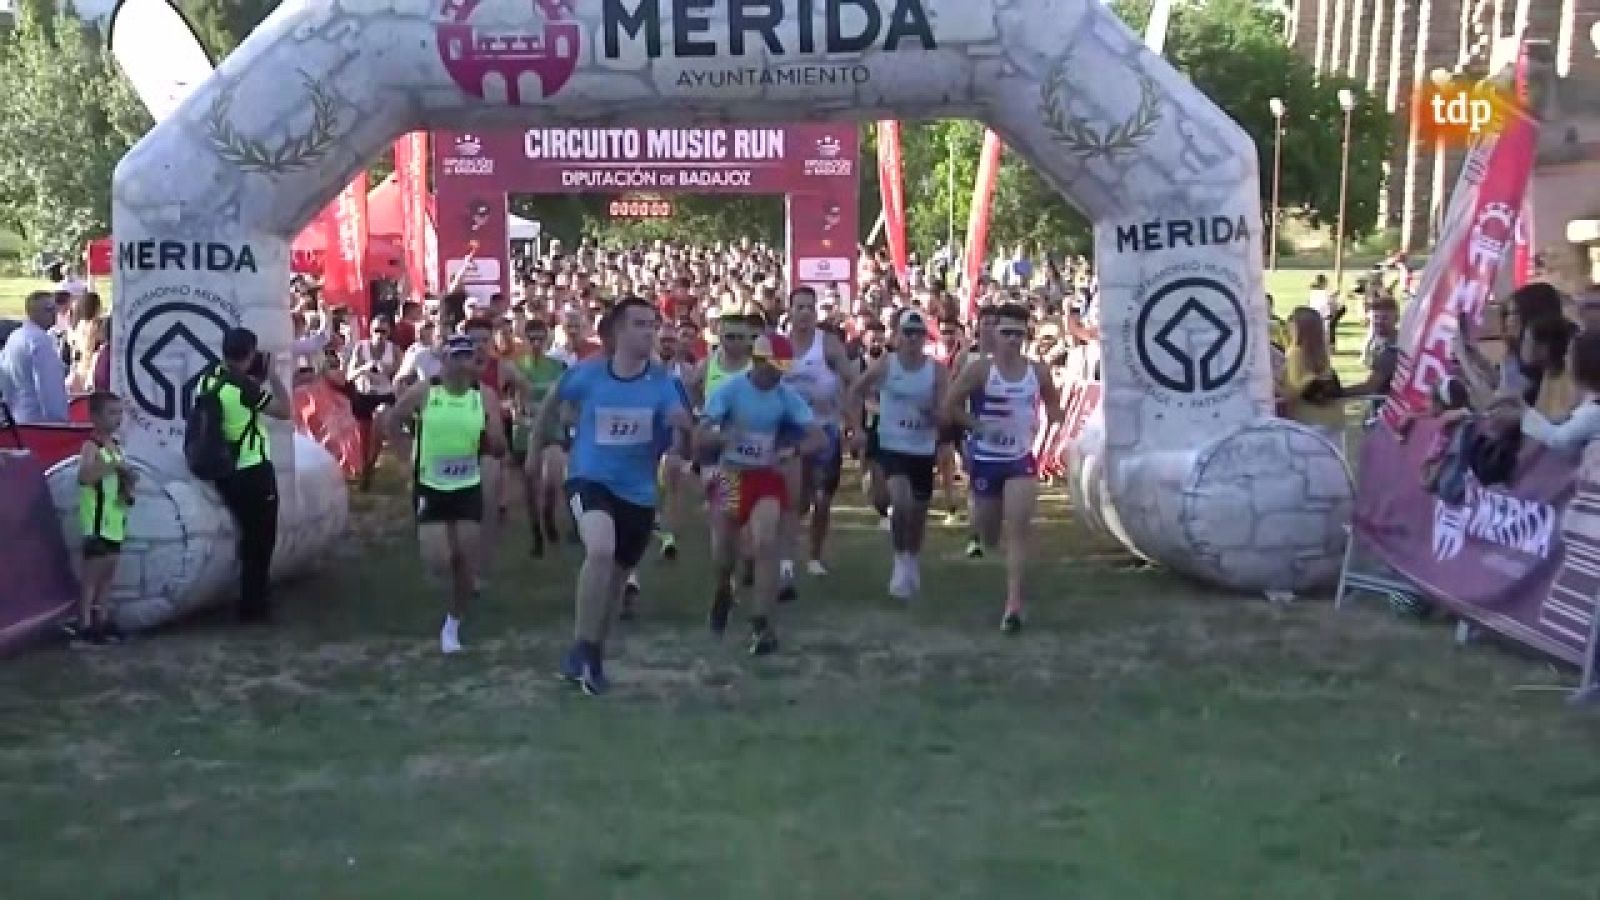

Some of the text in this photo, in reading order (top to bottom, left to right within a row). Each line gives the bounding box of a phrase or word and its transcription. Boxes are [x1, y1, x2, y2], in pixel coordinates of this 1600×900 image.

[676, 64, 871, 89] AYUNTAMIENTO
[523, 128, 785, 159] CIRCUITO MUSIC RUN
[561, 164, 656, 187] DIPUTACIÓN
[679, 169, 752, 186] BADAJOZ
[1116, 215, 1251, 253] MÉRIDA
[118, 237, 258, 273] MÉRIDA
